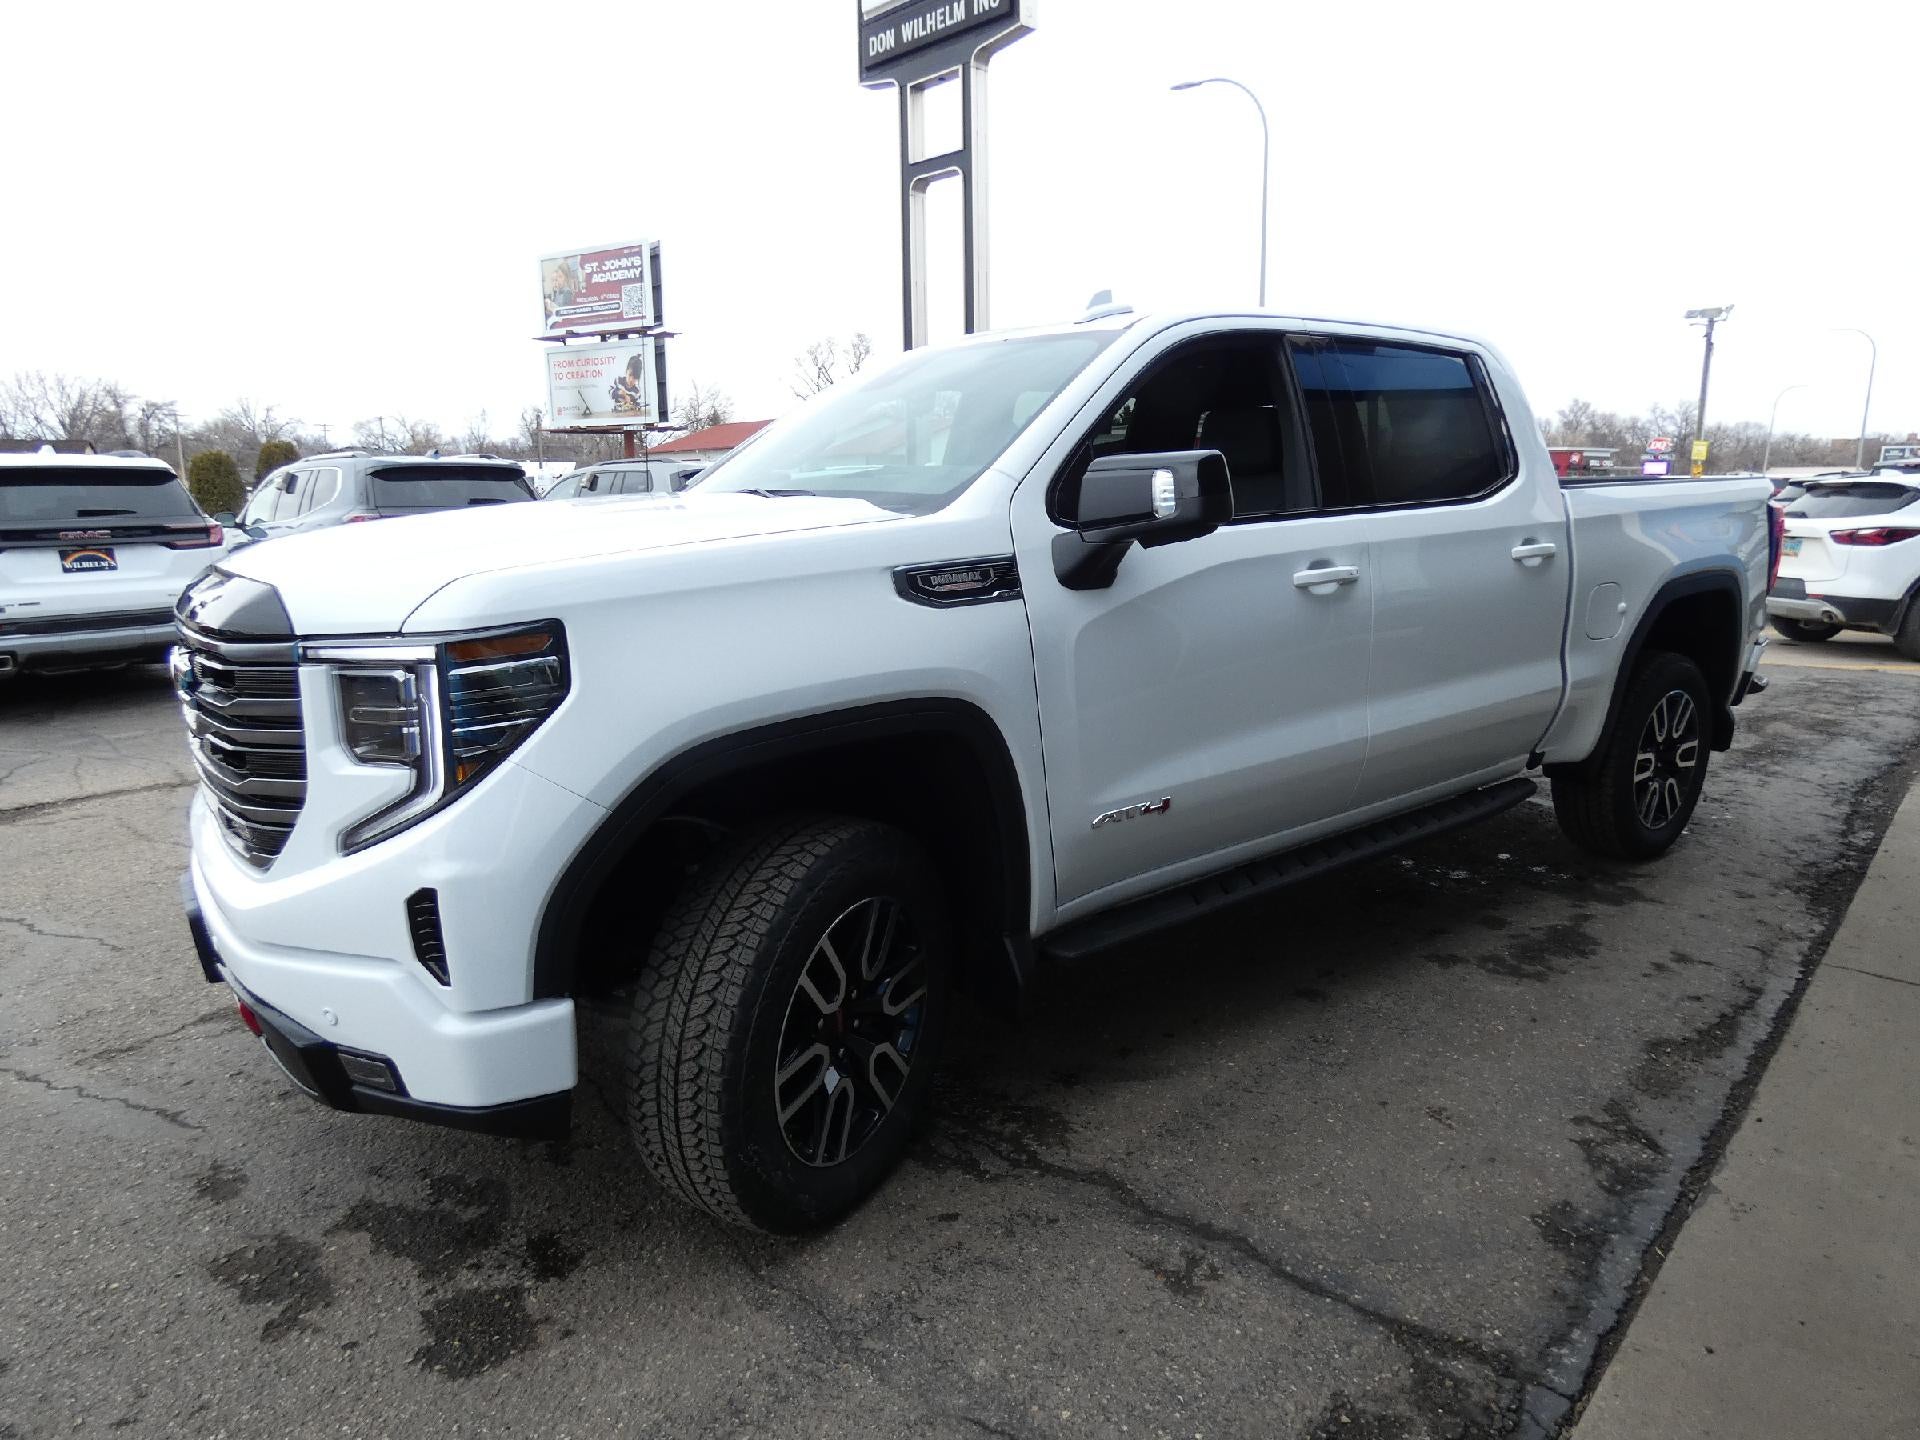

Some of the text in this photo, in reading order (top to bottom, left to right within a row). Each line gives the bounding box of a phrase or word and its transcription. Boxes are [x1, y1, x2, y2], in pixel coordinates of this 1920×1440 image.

[869, 28, 895, 57] DON
[901, 1, 966, 43] WILHELM
[584, 256, 642, 274] ST. JOHN'S
[591, 267, 642, 284] ACADEMY
[553, 355, 617, 369] FROM CURIOSITY
[554, 369, 603, 381] TO CREATION
[930, 570, 983, 586] DURAMAX
